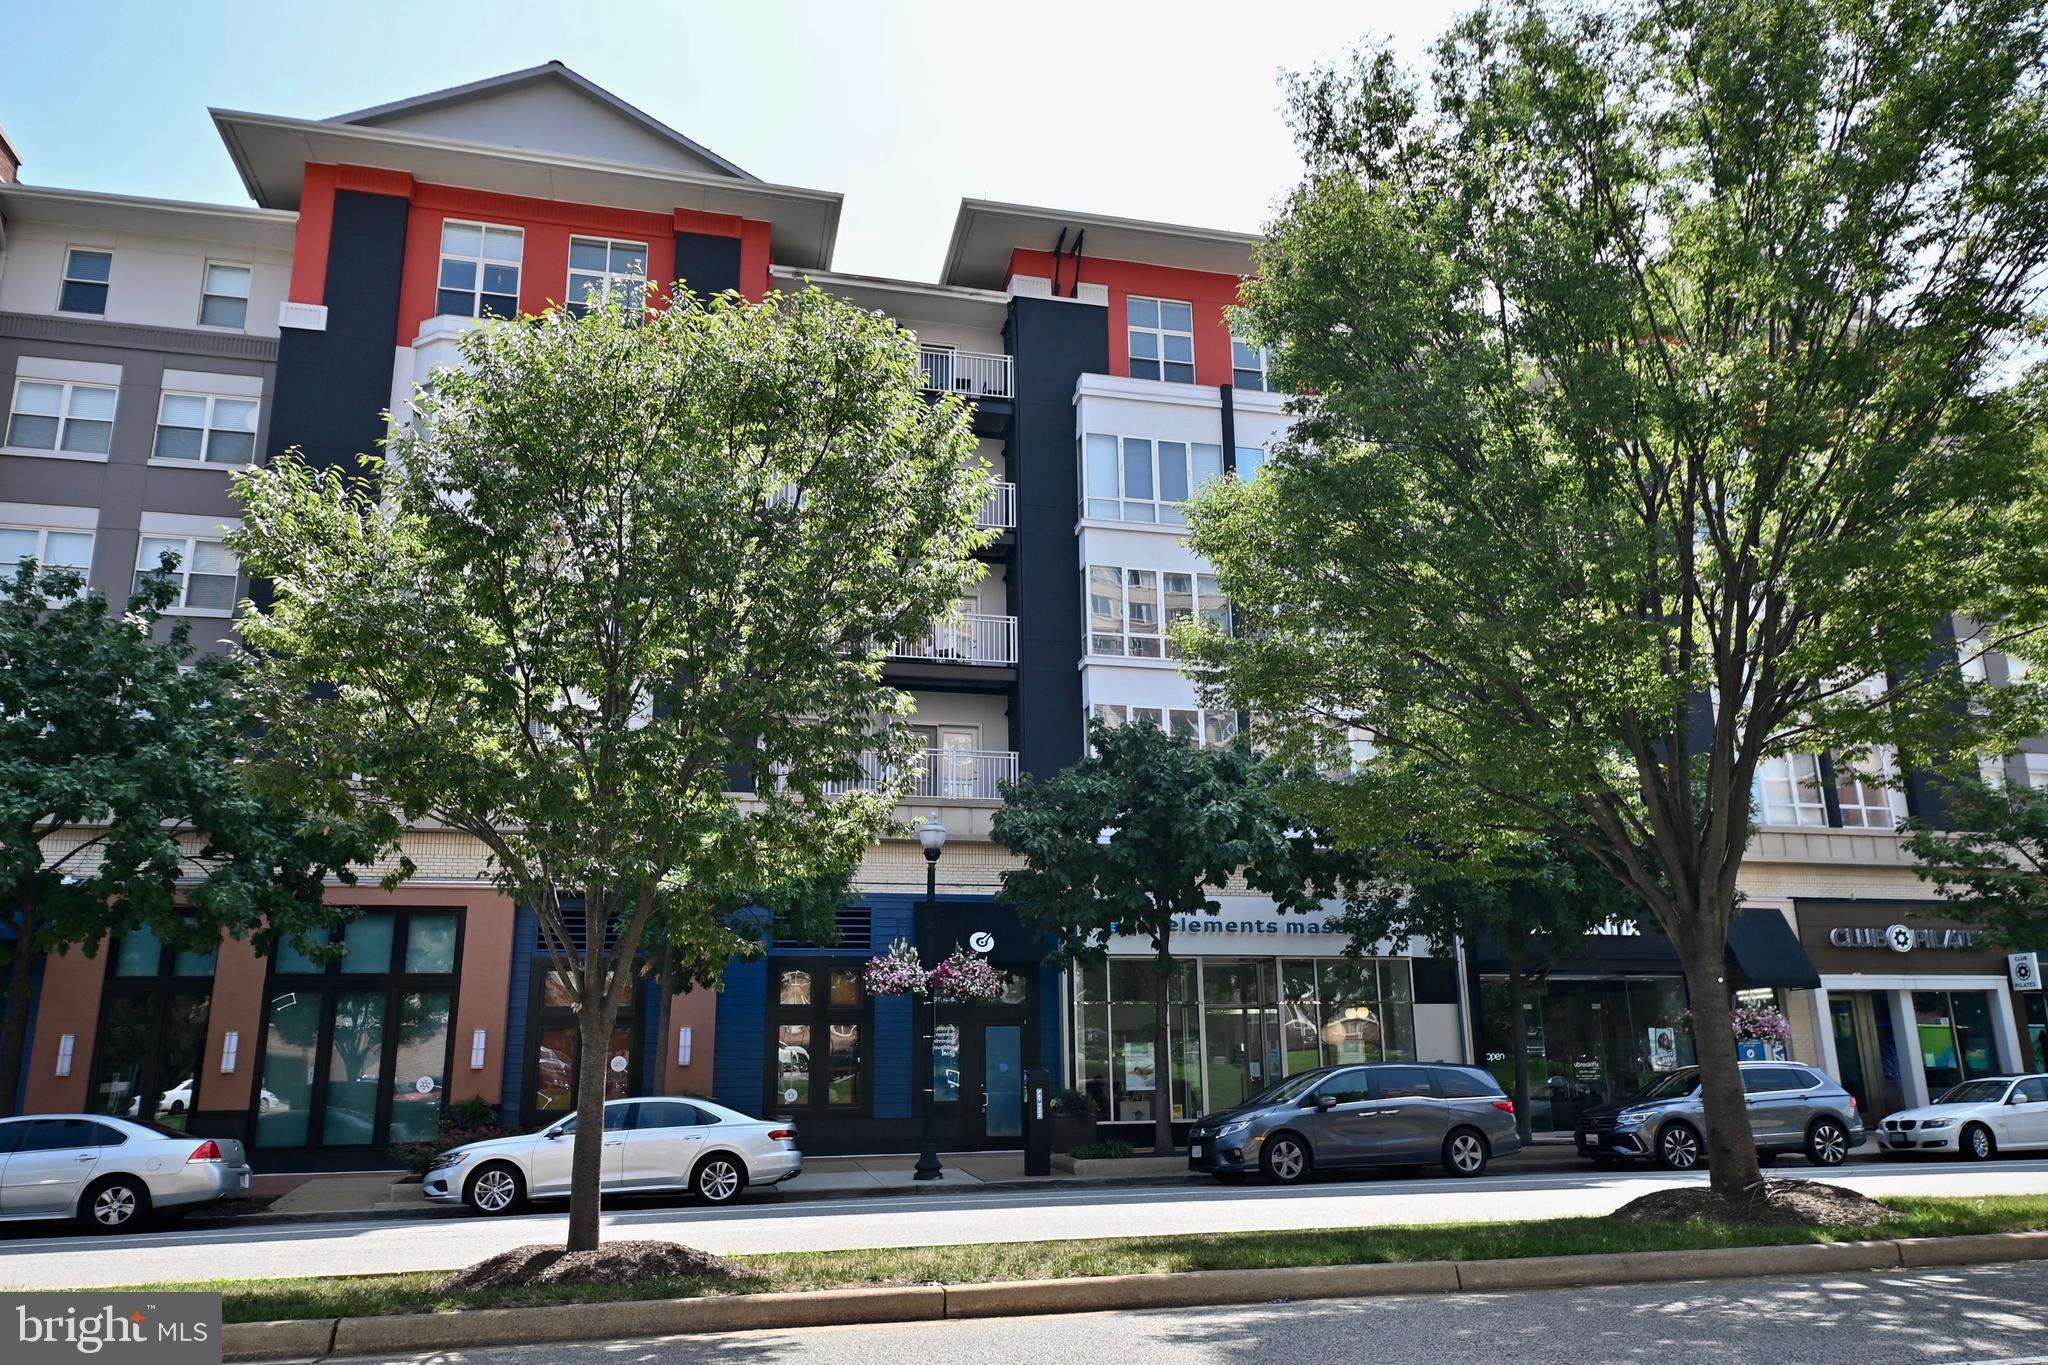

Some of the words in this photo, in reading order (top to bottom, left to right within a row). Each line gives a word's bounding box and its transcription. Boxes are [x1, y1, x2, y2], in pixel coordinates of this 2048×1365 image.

[1169, 917, 1278, 934] elements
[1829, 927, 1887, 948] CLUB
[1486, 1052, 1505, 1062] open
